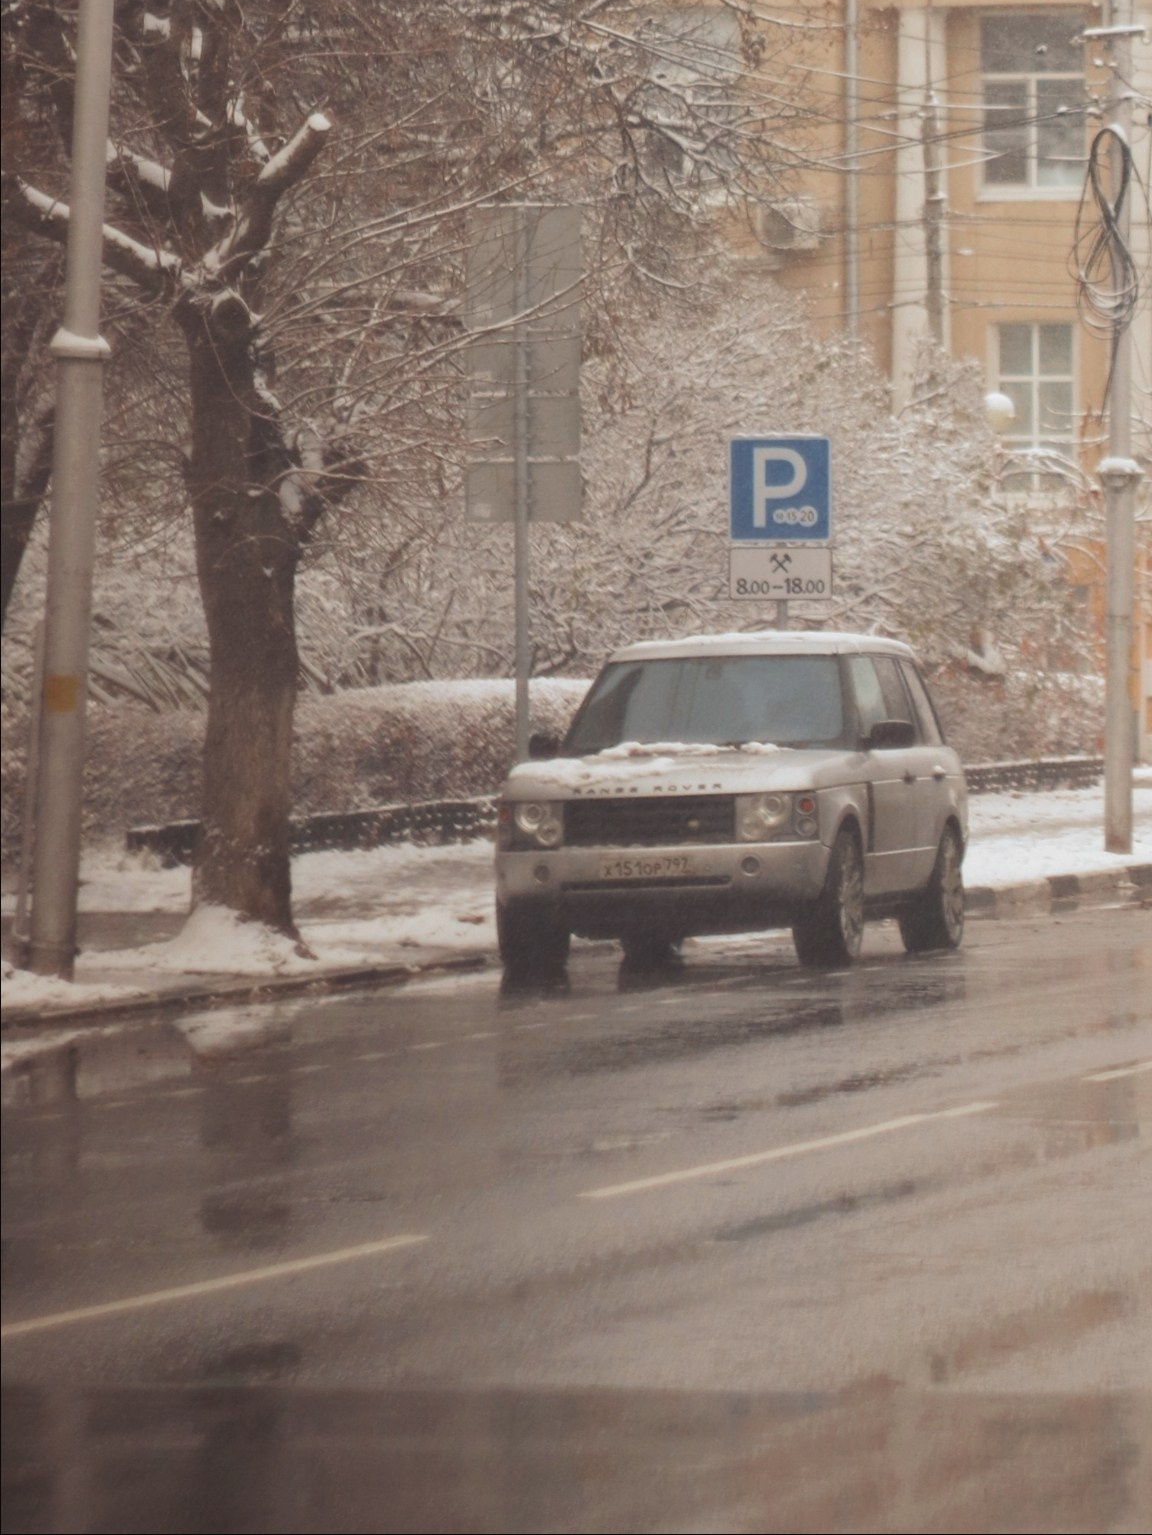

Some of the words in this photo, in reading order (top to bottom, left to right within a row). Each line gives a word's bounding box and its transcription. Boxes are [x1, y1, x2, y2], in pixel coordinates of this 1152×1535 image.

[753, 447, 807, 528] P
[800, 510, 815, 522] 20
[572, 786, 638, 795] RANGE
[653, 783, 722, 792] ROVER
